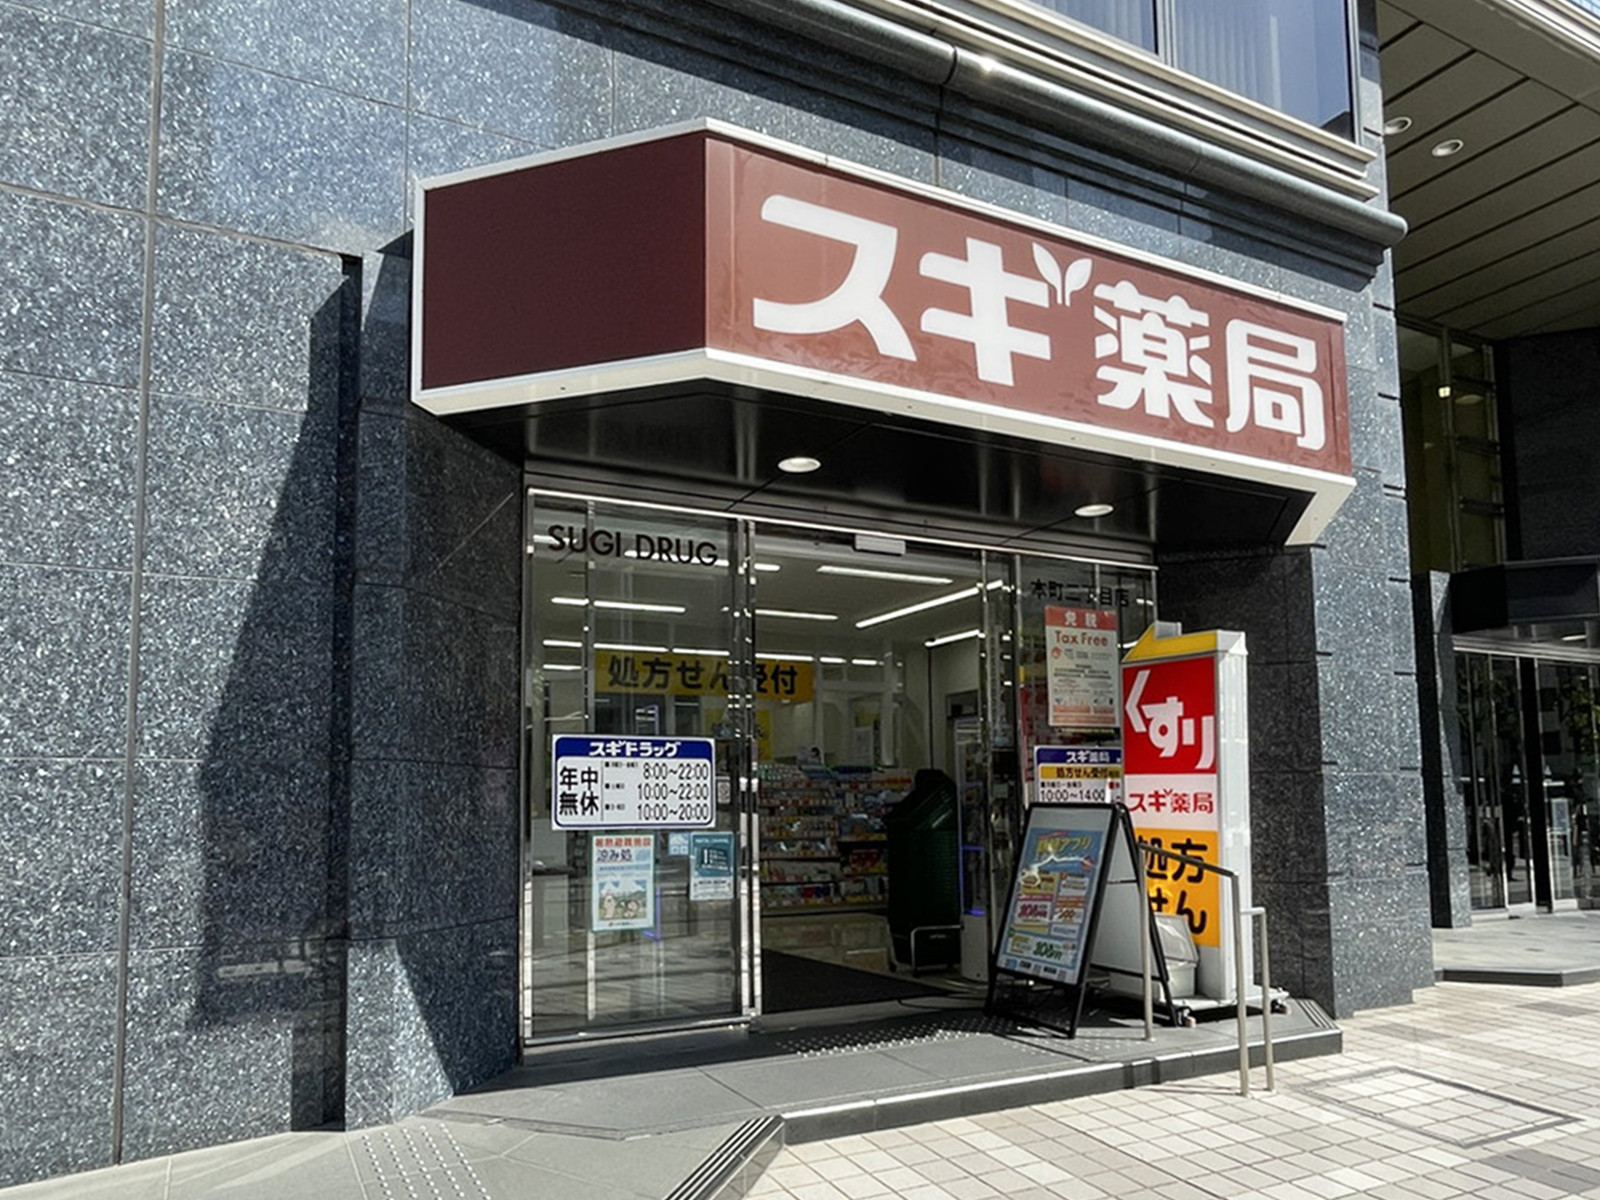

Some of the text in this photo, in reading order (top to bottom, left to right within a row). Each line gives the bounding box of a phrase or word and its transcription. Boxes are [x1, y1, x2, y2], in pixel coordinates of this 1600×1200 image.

[753, 194, 1326, 451] スギ薬局
[547, 524, 718, 567] SUGI DRUG
[1055, 630, 1109, 647] Tax Free
[1125, 669, 1214, 769] くすり
[589, 740, 681, 757] スギドラッグ
[559, 765, 599, 791] 年中
[559, 791, 600, 816] 無休
[1129, 788, 1214, 814] スギ薬局
